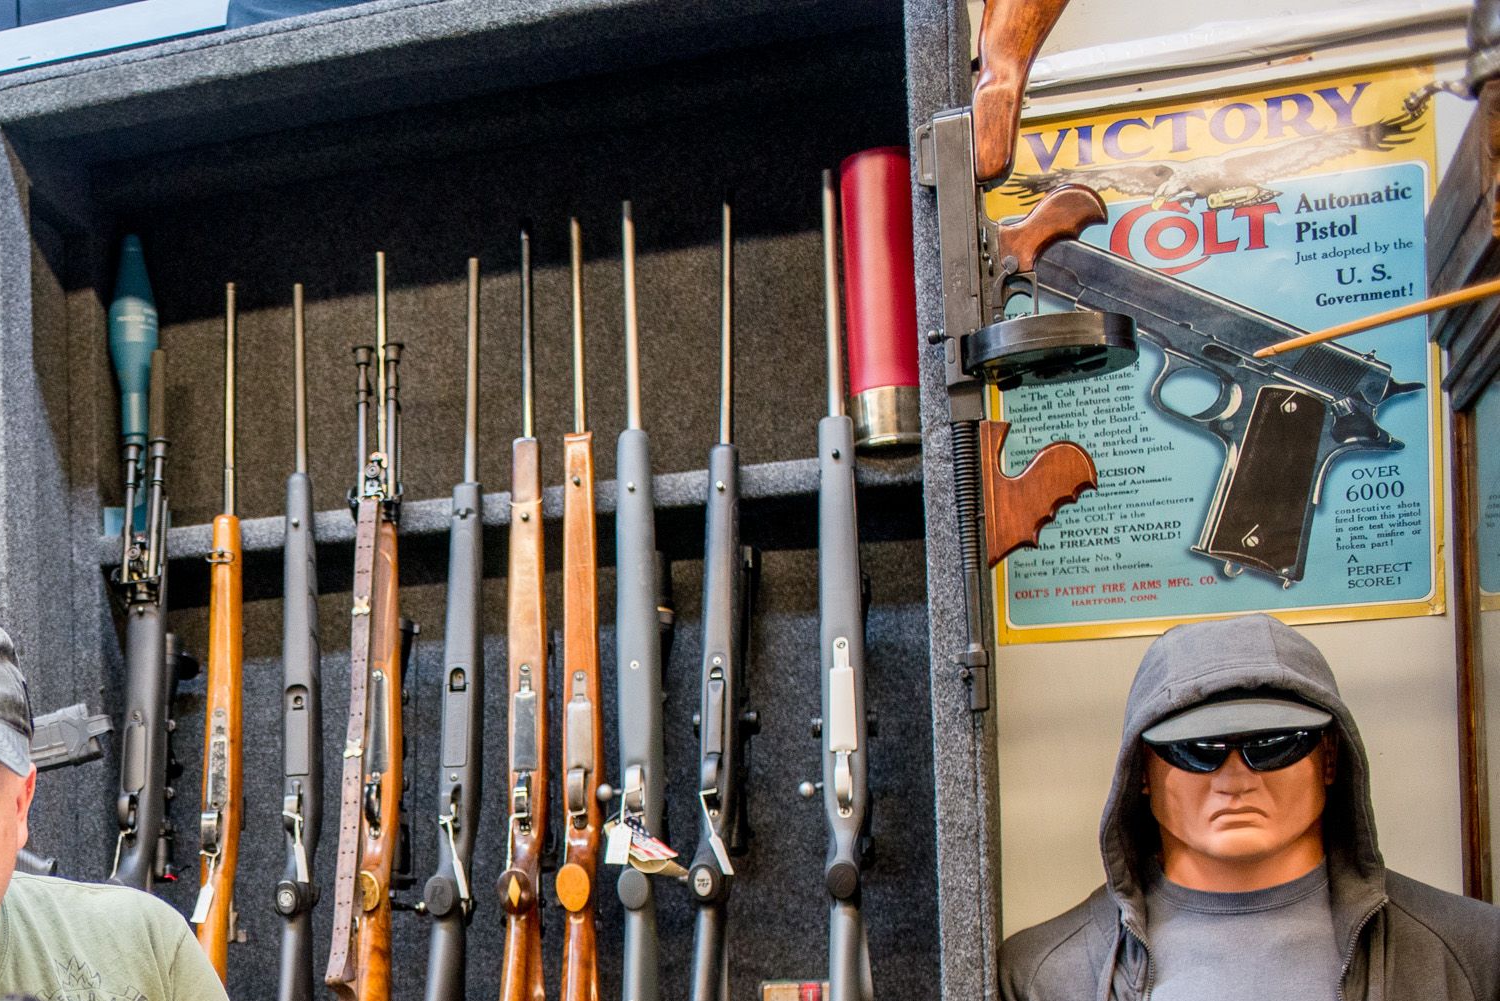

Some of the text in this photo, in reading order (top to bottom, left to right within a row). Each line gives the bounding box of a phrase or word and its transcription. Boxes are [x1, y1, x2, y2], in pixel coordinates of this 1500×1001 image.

[1022, 82, 1372, 172] VICTORY
[1294, 182, 1413, 215] Automatic
[1295, 214, 1358, 243] Pistol
[1110, 200, 1281, 275] COLT
[1295, 238, 1413, 265] Just adopted by the
[1336, 263, 1392, 285] U. S.
[1315, 282, 1414, 307] Government!
[1055, 388, 1076, 399] Colt
[1082, 382, 1110, 395] Pistol
[1116, 384, 1135, 393] em-
[1008, 394, 1135, 415] bodies all the features con-
[1009, 403, 1136, 424] sidered essential, desirable
[1009, 426, 1027, 436] and
[1028, 420, 1075, 434] preferable
[1077, 418, 1089, 430] by
[1092, 417, 1107, 427] the
[1022, 425, 1149, 445] The Colt is adopted in
[1086, 440, 1097, 450] its
[1102, 435, 1138, 447] marked
[1142, 435, 1156, 443] su-
[1091, 442, 1175, 459] ther known pistol.
[1097, 465, 1146, 479] ECISION
[1351, 465, 1401, 480] OVER
[1118, 479, 1128, 487] of
[1130, 476, 1173, 486] Automatic
[1095, 488, 1140, 500] Supremacy
[1346, 480, 1405, 502] 6000
[1072, 505, 1095, 514] what
[1098, 502, 1123, 512] other
[1126, 497, 1195, 508] manufacturers
[1335, 501, 1421, 515] consecutive shots
[1065, 516, 1081, 525] the
[1084, 512, 1115, 523] COLT
[1120, 511, 1128, 519] is
[1130, 510, 1146, 519] the
[1335, 508, 1421, 525] fired from this pistol
[1060, 520, 1182, 539] PROVEN STANDARD
[1335, 525, 1343, 533] in
[1369, 522, 1384, 530] test
[1388, 519, 1422, 529] without
[1376, 529, 1405, 539] misfire
[1411, 528, 1422, 536] or
[1038, 542, 1056, 551] the
[1060, 536, 1121, 550] FIREARMS
[1130, 531, 1182, 543] WORLD!
[1336, 539, 1394, 551] broken part!
[1013, 559, 1037, 568] Send
[1041, 557, 1055, 566] for
[1059, 554, 1090, 566] Folder
[1095, 553, 1112, 562] No.
[1347, 554, 1358, 564] A
[1023, 568, 1048, 579] gives
[1094, 564, 1110, 573] not
[1112, 561, 1154, 571] theories.
[1347, 561, 1413, 577] PERFECT
[1015, 575, 1218, 600] COLT'S PATENT FIRE ARMS MFG. CO.
[1348, 576, 1402, 589] SCORE!
[1071, 596, 1127, 607] HARTFORD,
